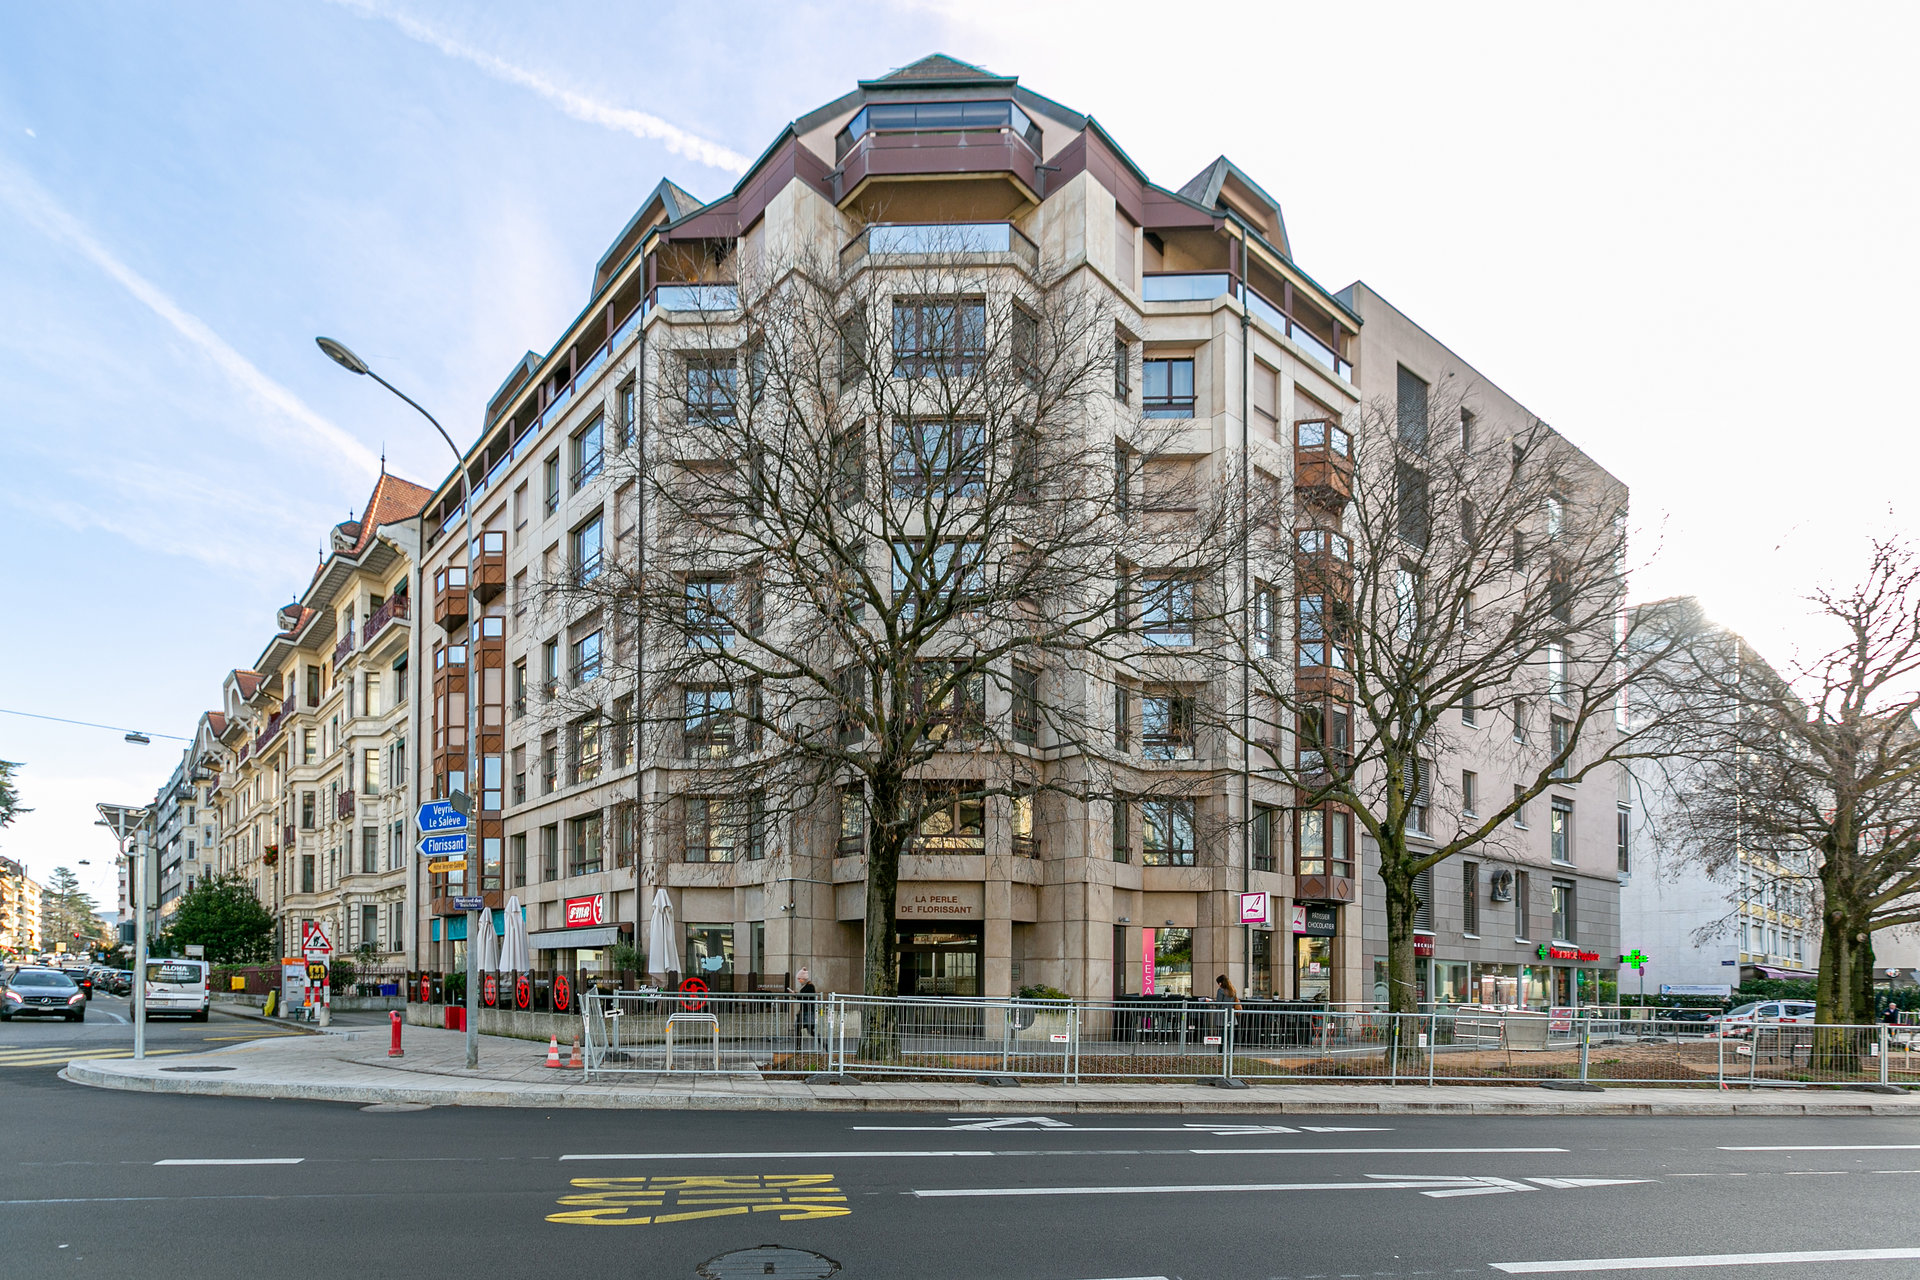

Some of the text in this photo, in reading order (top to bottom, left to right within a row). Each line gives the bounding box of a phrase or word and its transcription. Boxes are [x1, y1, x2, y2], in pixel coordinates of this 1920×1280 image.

[433, 803, 457, 816] Veyrie
[429, 815, 461, 828] Le Salève
[428, 837, 464, 852] Florissant
[915, 895, 958, 903] LA PERLE
[901, 905, 972, 914] DE FLORISSANT
[1308, 921, 1335, 930] CHOCOLATIER
[1550, 946, 1577, 960] Pharmacie
[1144, 953, 1153, 995] LESA
